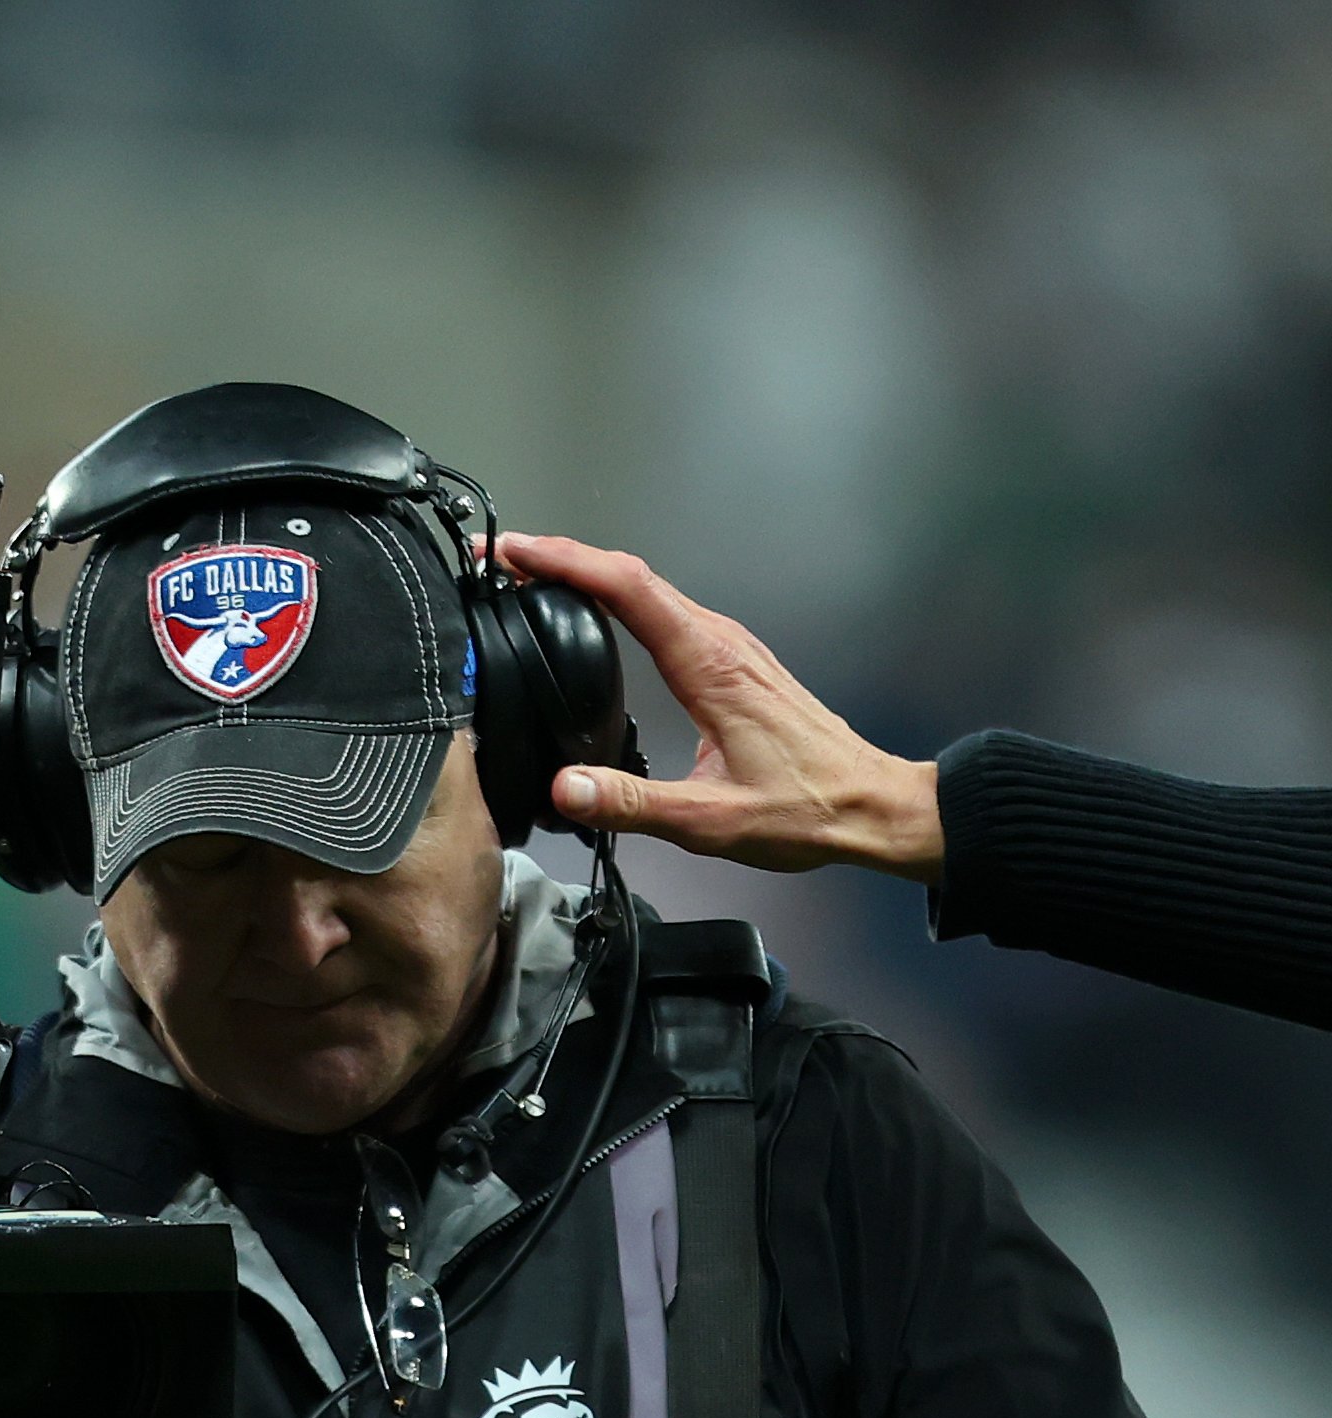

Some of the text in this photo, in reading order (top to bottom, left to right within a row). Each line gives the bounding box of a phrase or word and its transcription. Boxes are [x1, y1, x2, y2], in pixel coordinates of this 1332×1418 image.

[168, 559, 295, 608] FC DALLAS
[216, 594, 245, 609] 96
